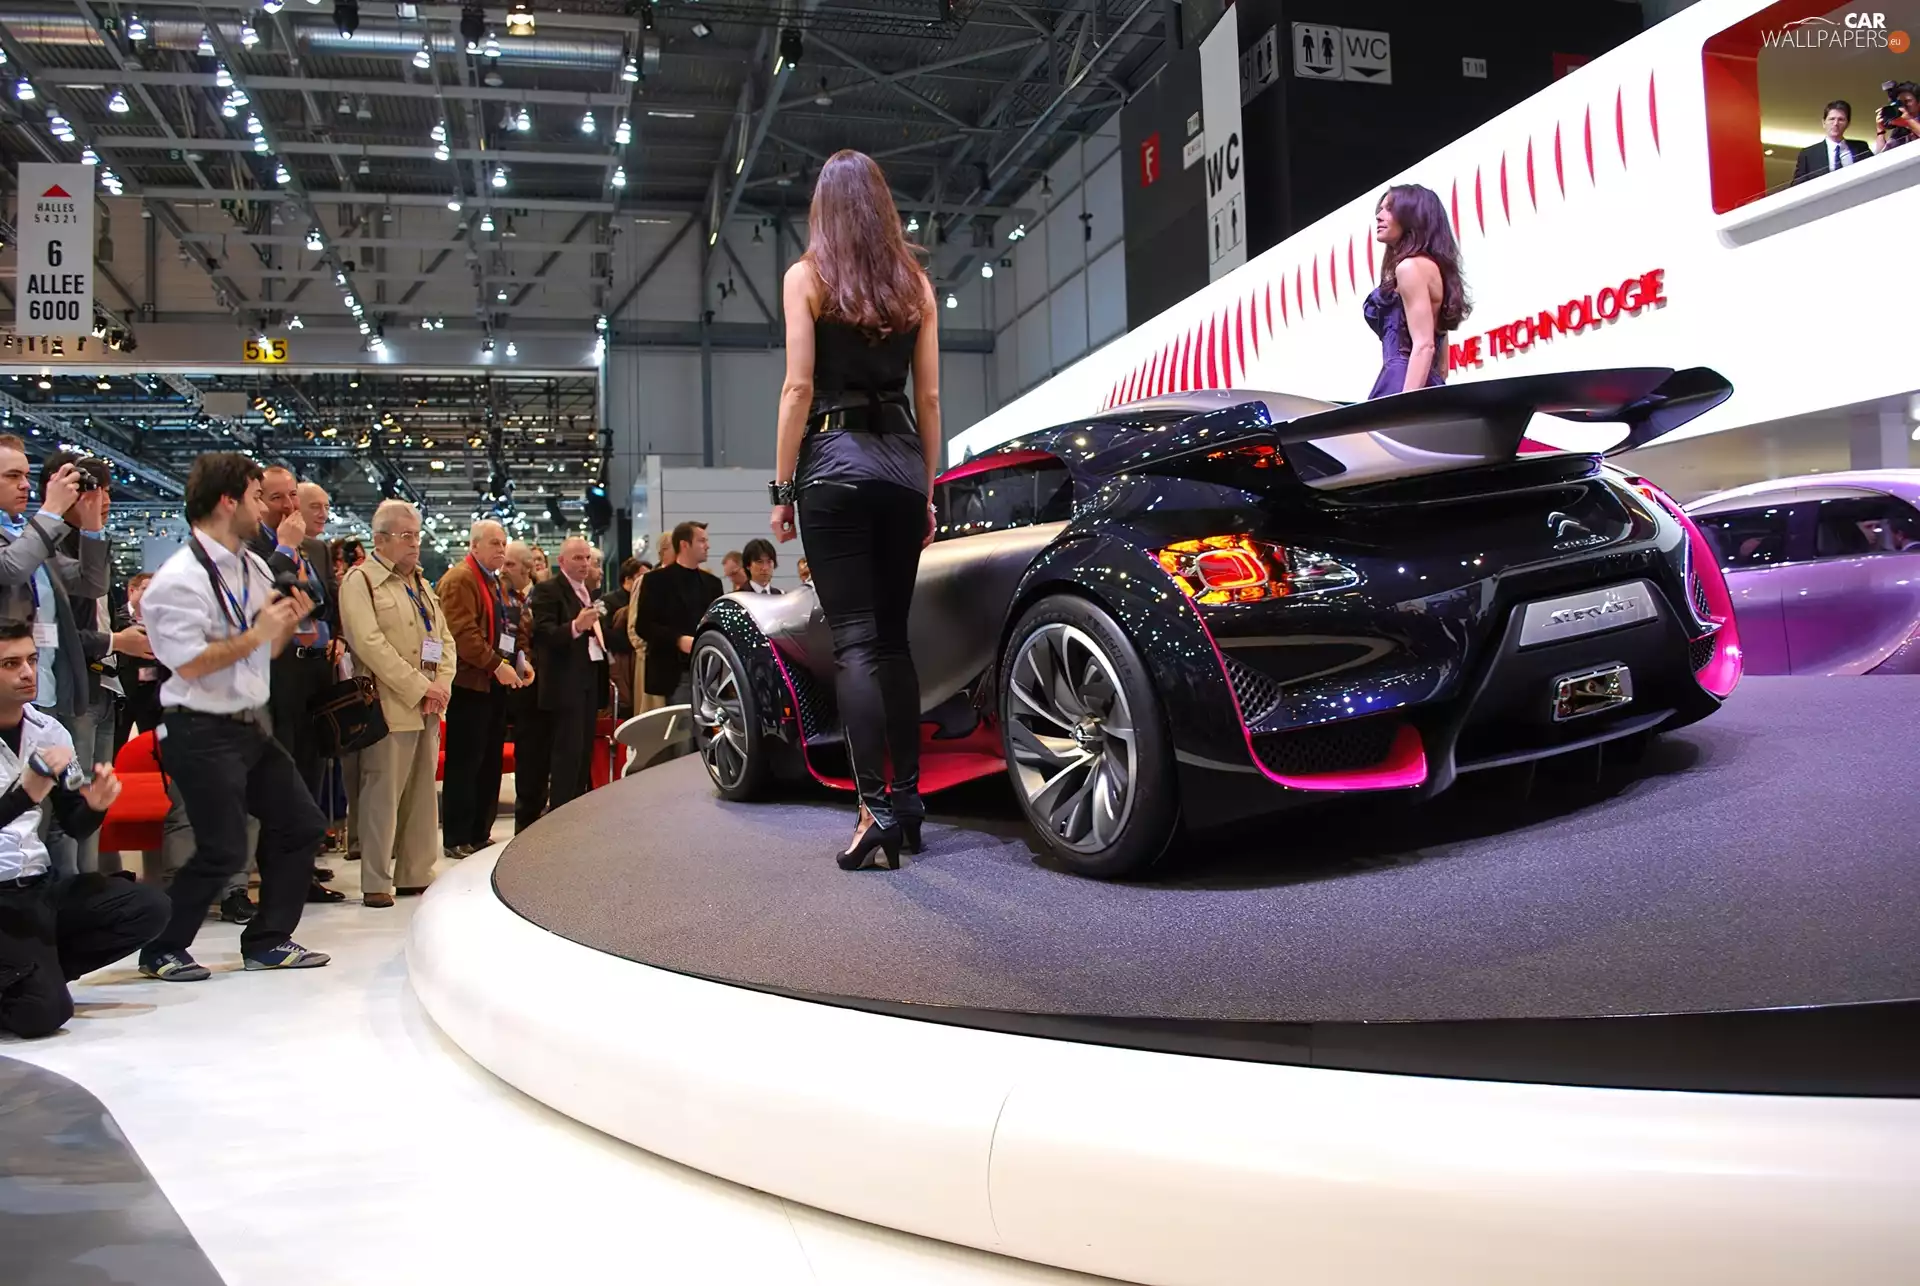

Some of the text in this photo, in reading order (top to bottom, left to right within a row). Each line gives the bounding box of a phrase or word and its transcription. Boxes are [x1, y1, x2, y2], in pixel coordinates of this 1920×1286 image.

[1346, 35, 1388, 60] WC
[1207, 132, 1239, 198] WC
[34, 213, 77, 224] 5 4 3 2 1
[37, 202, 75, 213] HALLES
[47, 239, 62, 267] 6
[27, 274, 84, 294] ALLEE
[29, 300, 80, 321] 6000
[1484, 268, 1667, 358] TECHNOLOGIE
